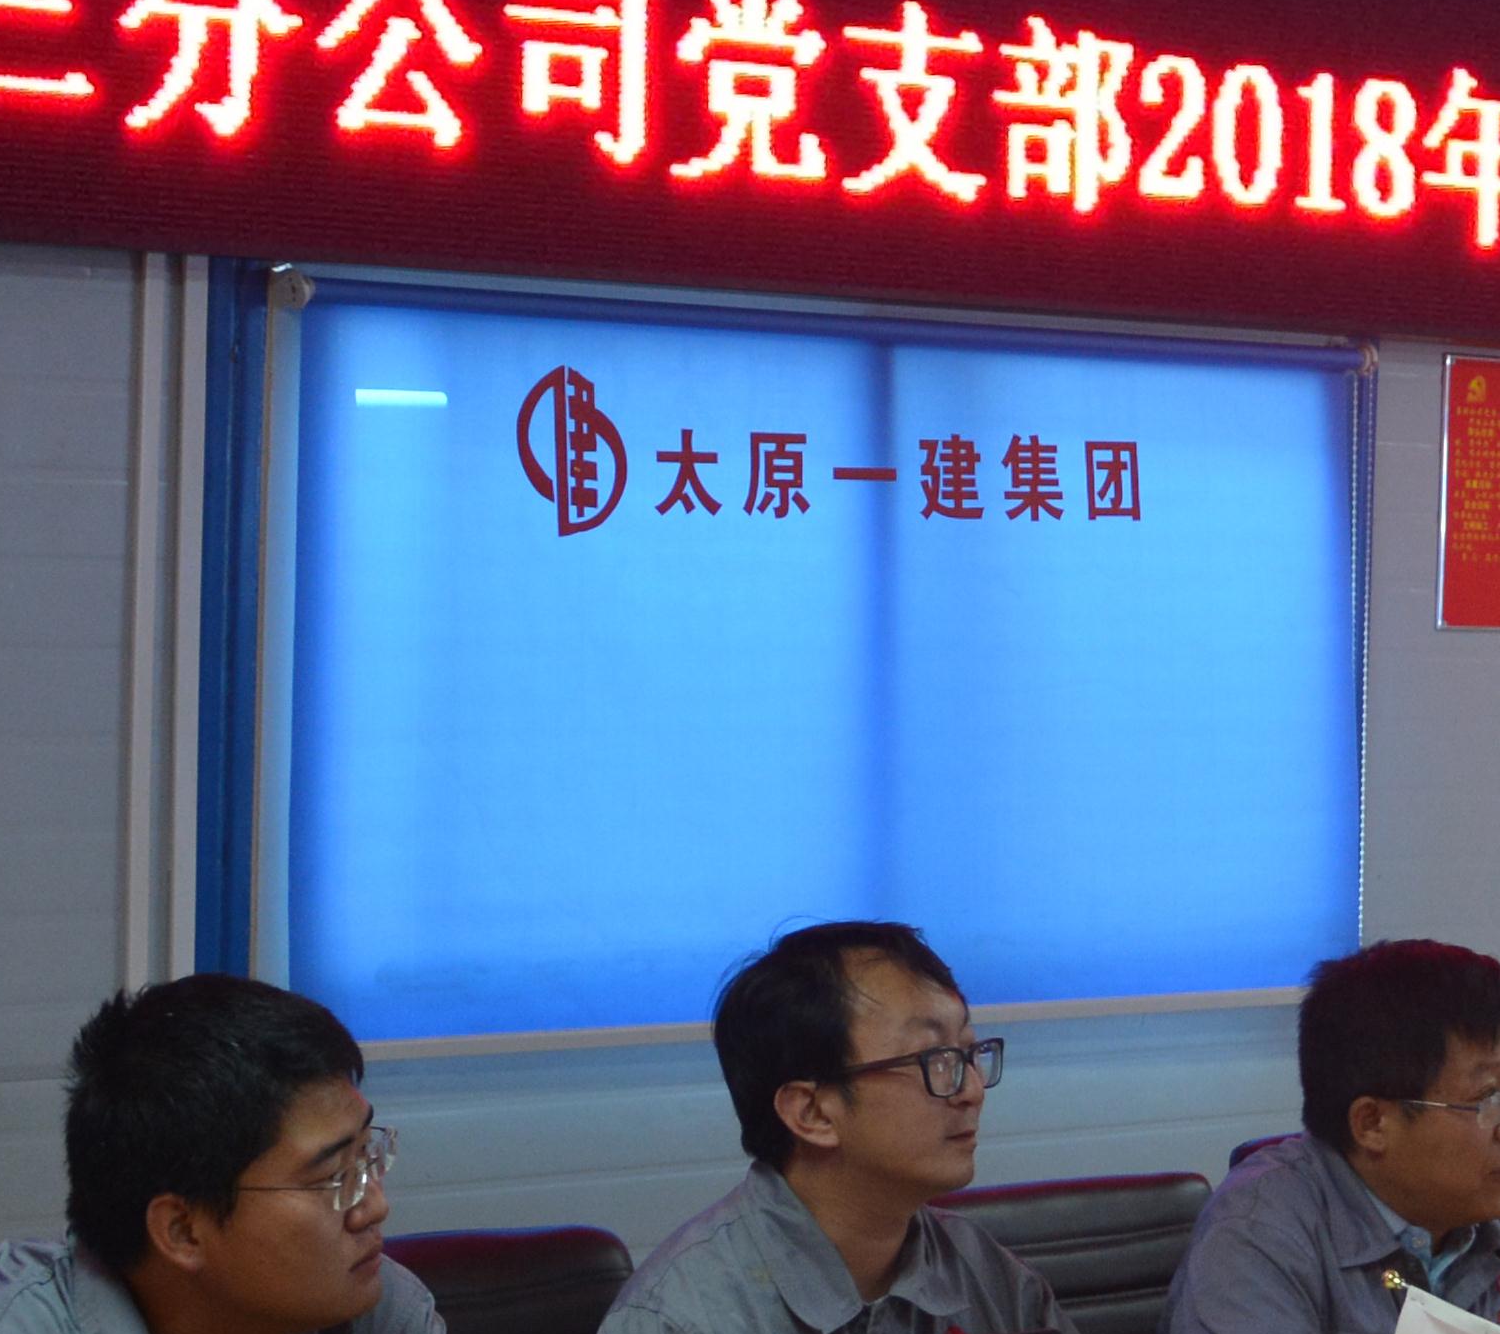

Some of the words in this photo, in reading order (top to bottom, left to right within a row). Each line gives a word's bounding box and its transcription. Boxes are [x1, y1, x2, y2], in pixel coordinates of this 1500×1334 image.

[654, 428, 1143, 523] 太原一建集团
